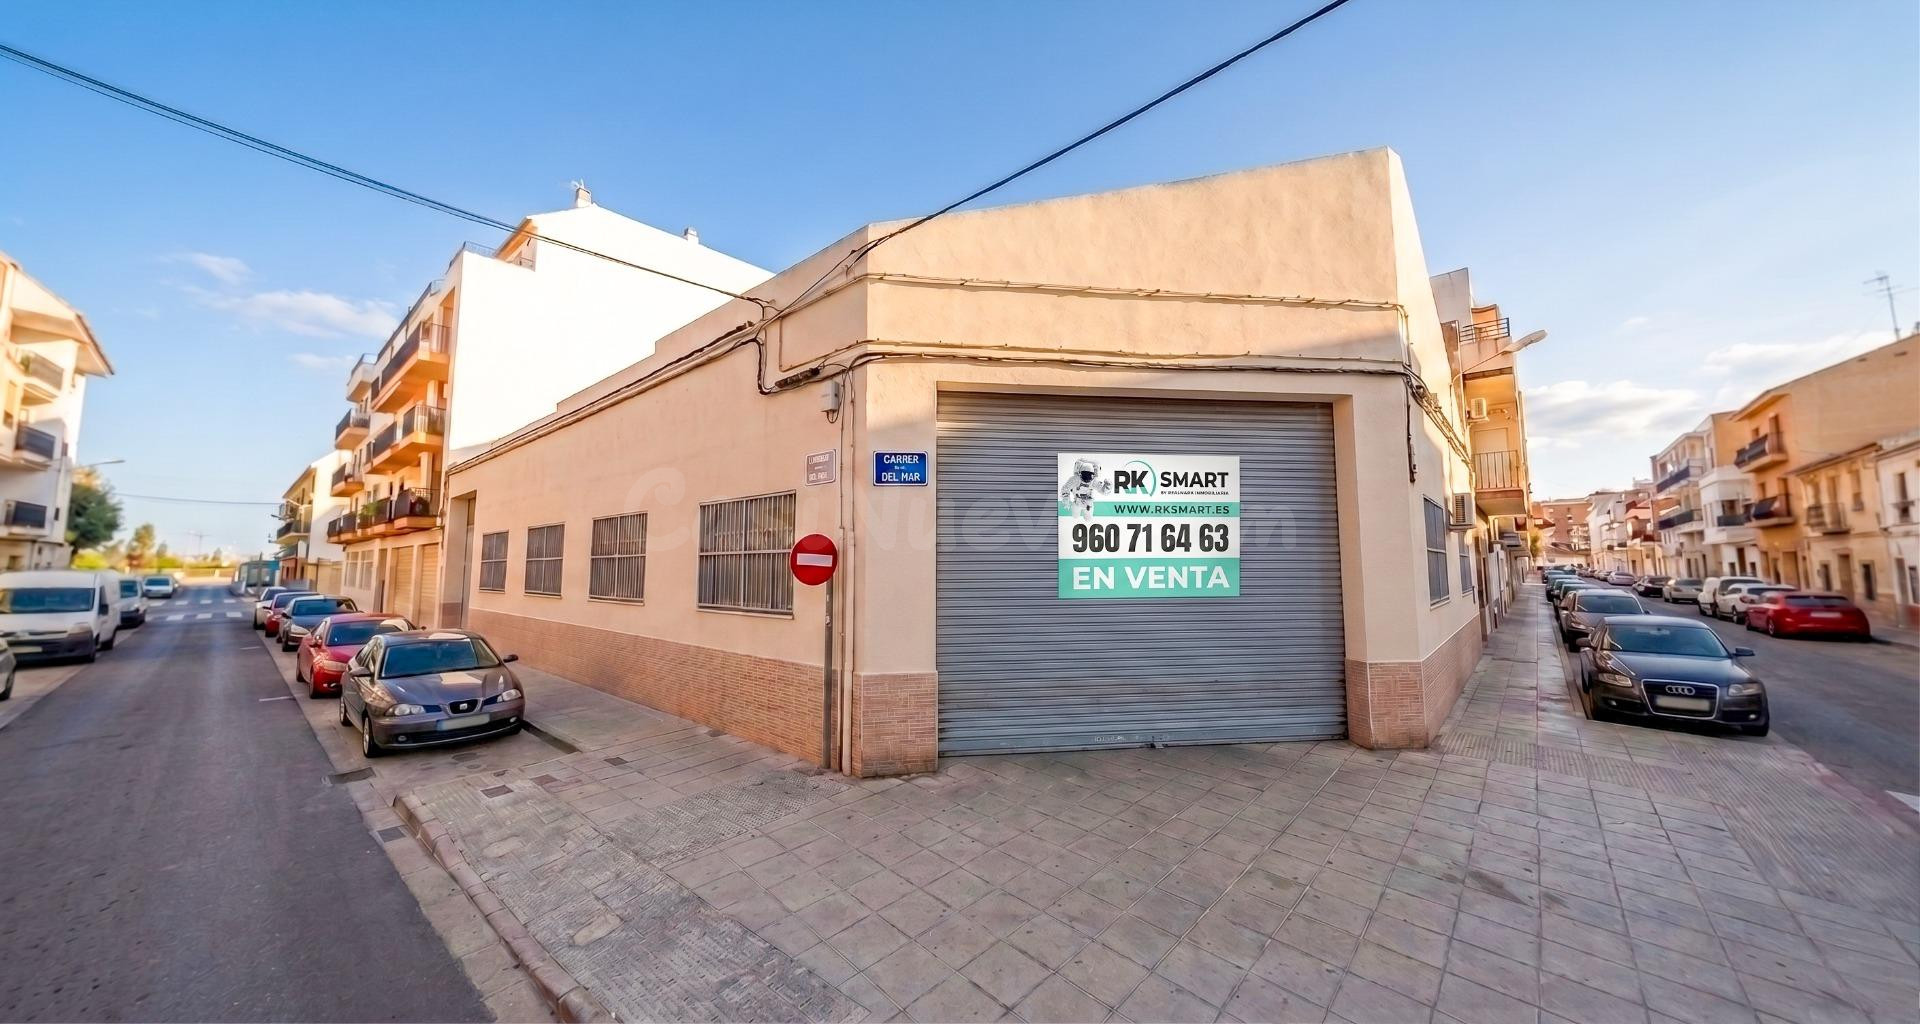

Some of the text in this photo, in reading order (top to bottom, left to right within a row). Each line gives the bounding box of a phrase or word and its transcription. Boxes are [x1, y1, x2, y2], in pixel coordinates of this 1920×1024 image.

[883, 454, 919, 464] CARRER
[881, 472, 921, 482] DEL MAR
[1114, 470, 1229, 495] RK SMART
[1114, 504, 1230, 515] WWW.RKSMART.ES
[1072, 523, 1229, 553] 960 71 64 63
[1073, 565, 1230, 590] EN VENTA
